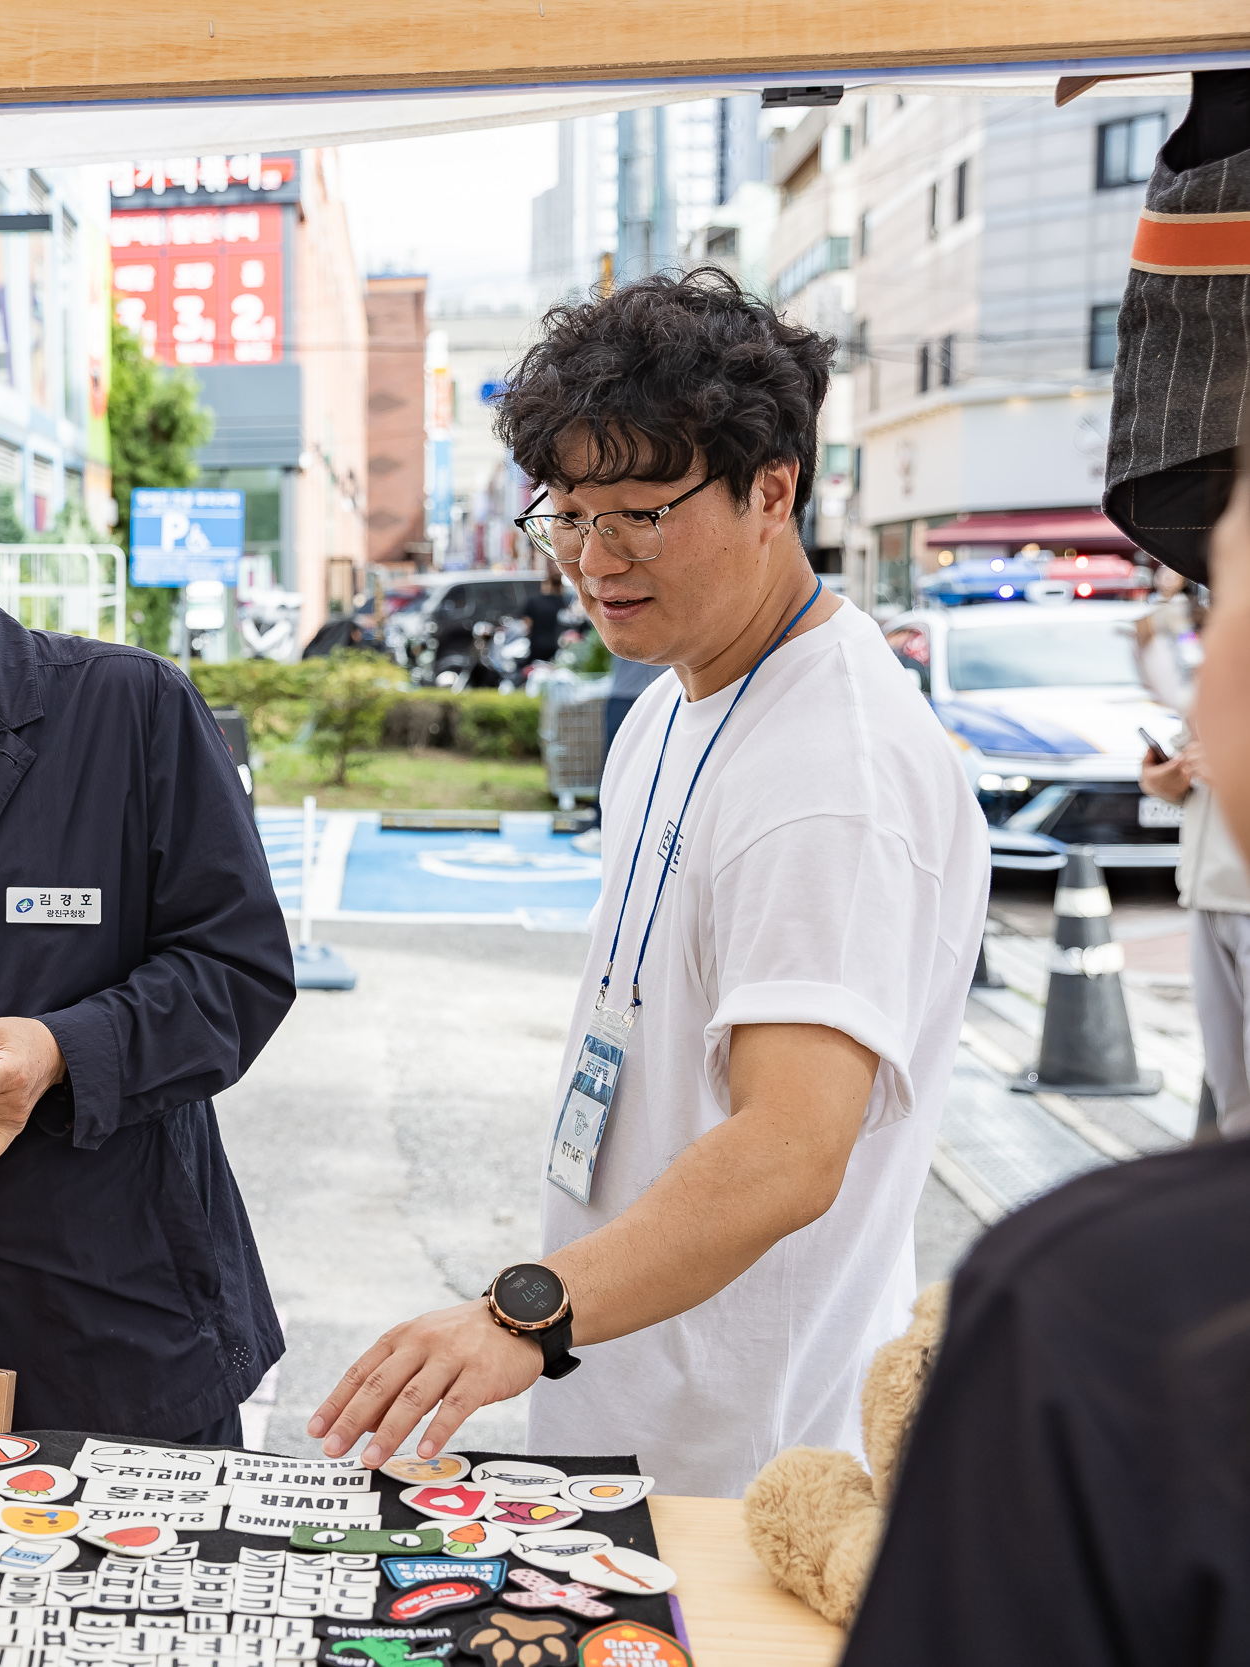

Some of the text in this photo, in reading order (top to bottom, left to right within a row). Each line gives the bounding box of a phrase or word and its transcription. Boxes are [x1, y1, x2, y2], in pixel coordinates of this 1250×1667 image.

[46, 909, 86, 919] 광진구청장
[560, 1140, 586, 1166] STAFF
[521, 1280, 549, 1303] 15:17
[233, 1456, 355, 1469] ALLERGIC
[90, 1461, 202, 1481] 예민보스
[231, 1471, 364, 1486] DO NOT PET
[106, 1486, 210, 1504] 훈련중
[260, 1493, 348, 1511] LOVER
[14, 1551, 43, 1561] MILK
[414, 1563, 477, 1573] BUDDY
[326, 1625, 452, 1639] unstoppable
[603, 1638, 661, 1652] CLUB
[611, 1648, 656, 1660] RUB
